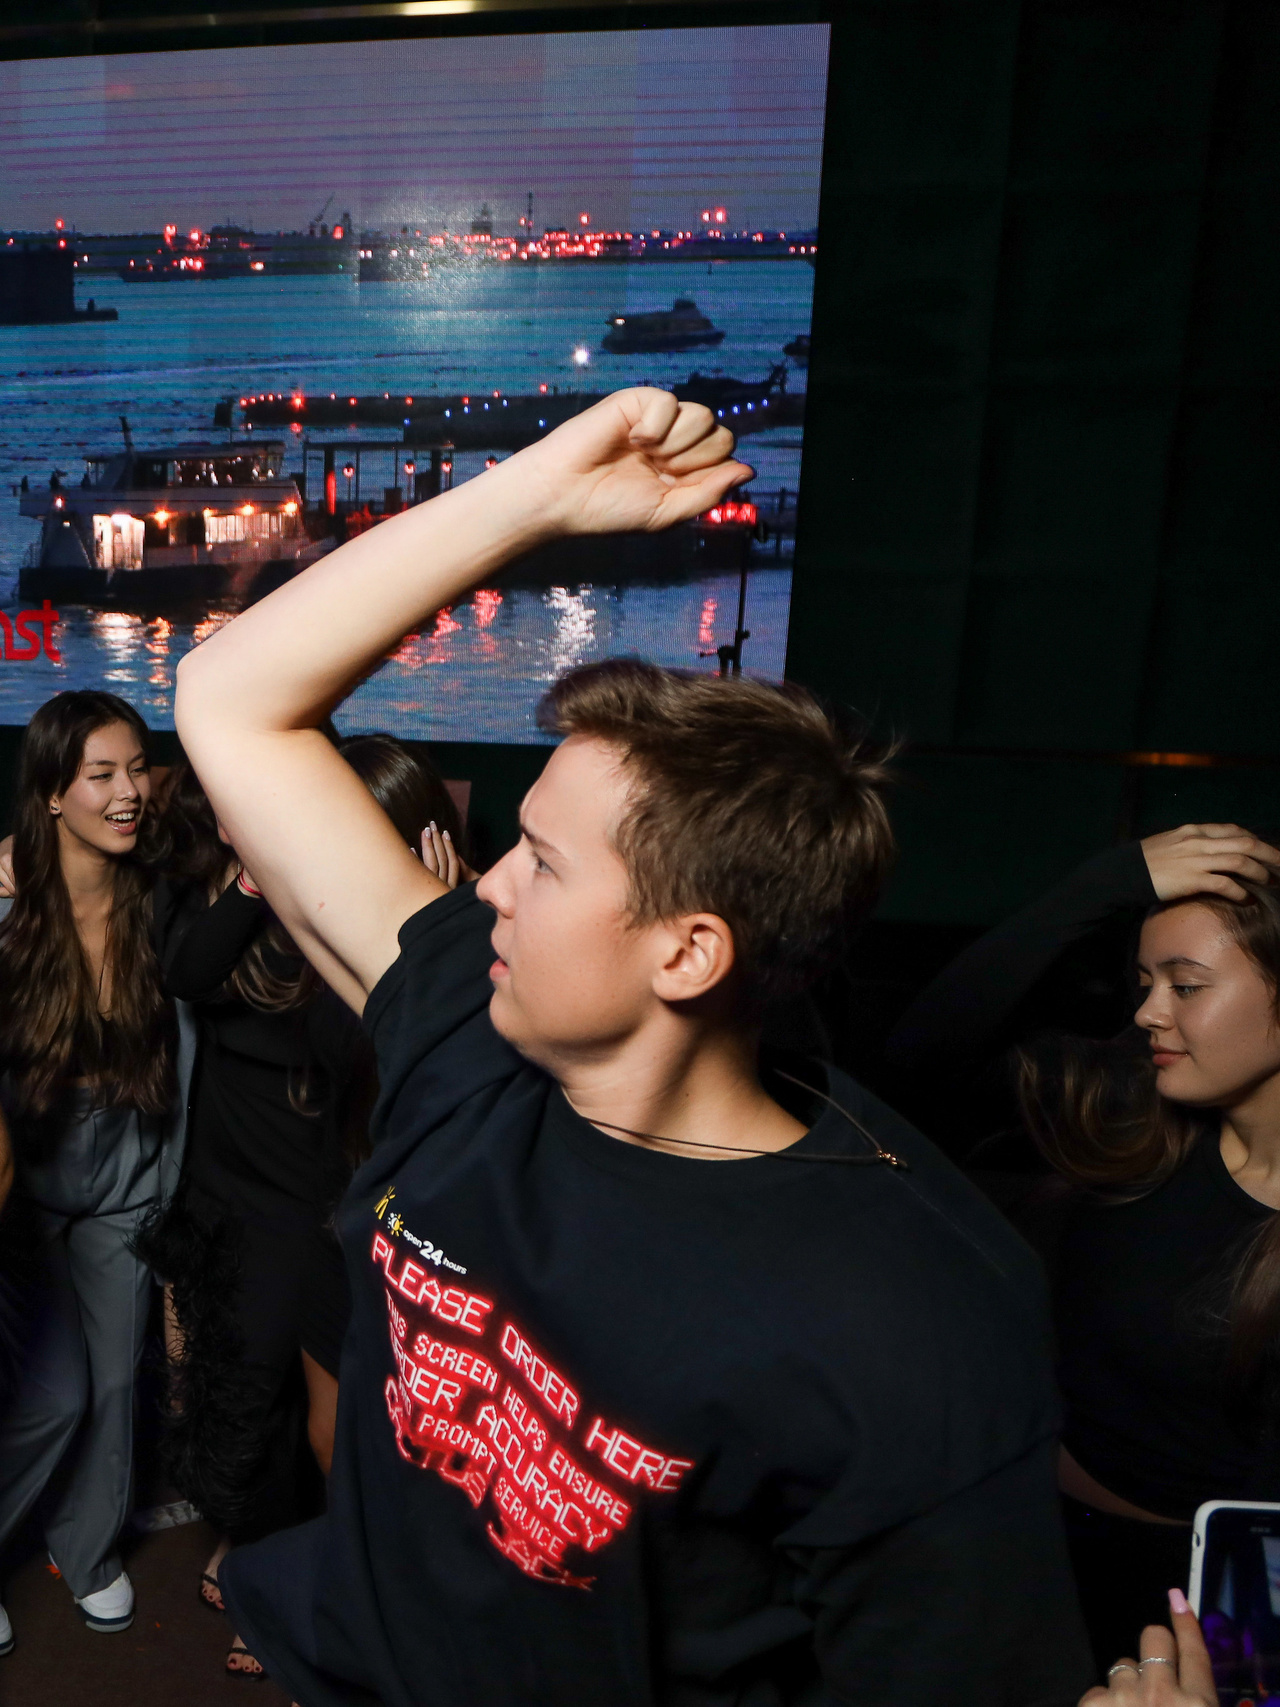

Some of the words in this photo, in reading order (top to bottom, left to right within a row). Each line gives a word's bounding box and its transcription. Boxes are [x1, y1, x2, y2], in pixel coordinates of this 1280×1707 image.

[403, 1229, 423, 1248] open
[419, 1240, 444, 1266] 24
[442, 1257, 468, 1275] hours
[371, 1233, 492, 1334] PLEASE
[500, 1324, 580, 1429] ORDER
[585, 1417, 693, 1491] HERE
[414, 1333, 498, 1392] SCREEN
[502, 1386, 548, 1453] HELPS
[548, 1449, 629, 1526] ENSURE
[418, 1413, 499, 1476] PROMPT
[494, 1476, 565, 1560] SERVICE
[475, 1403, 608, 1549] ACCURACY
